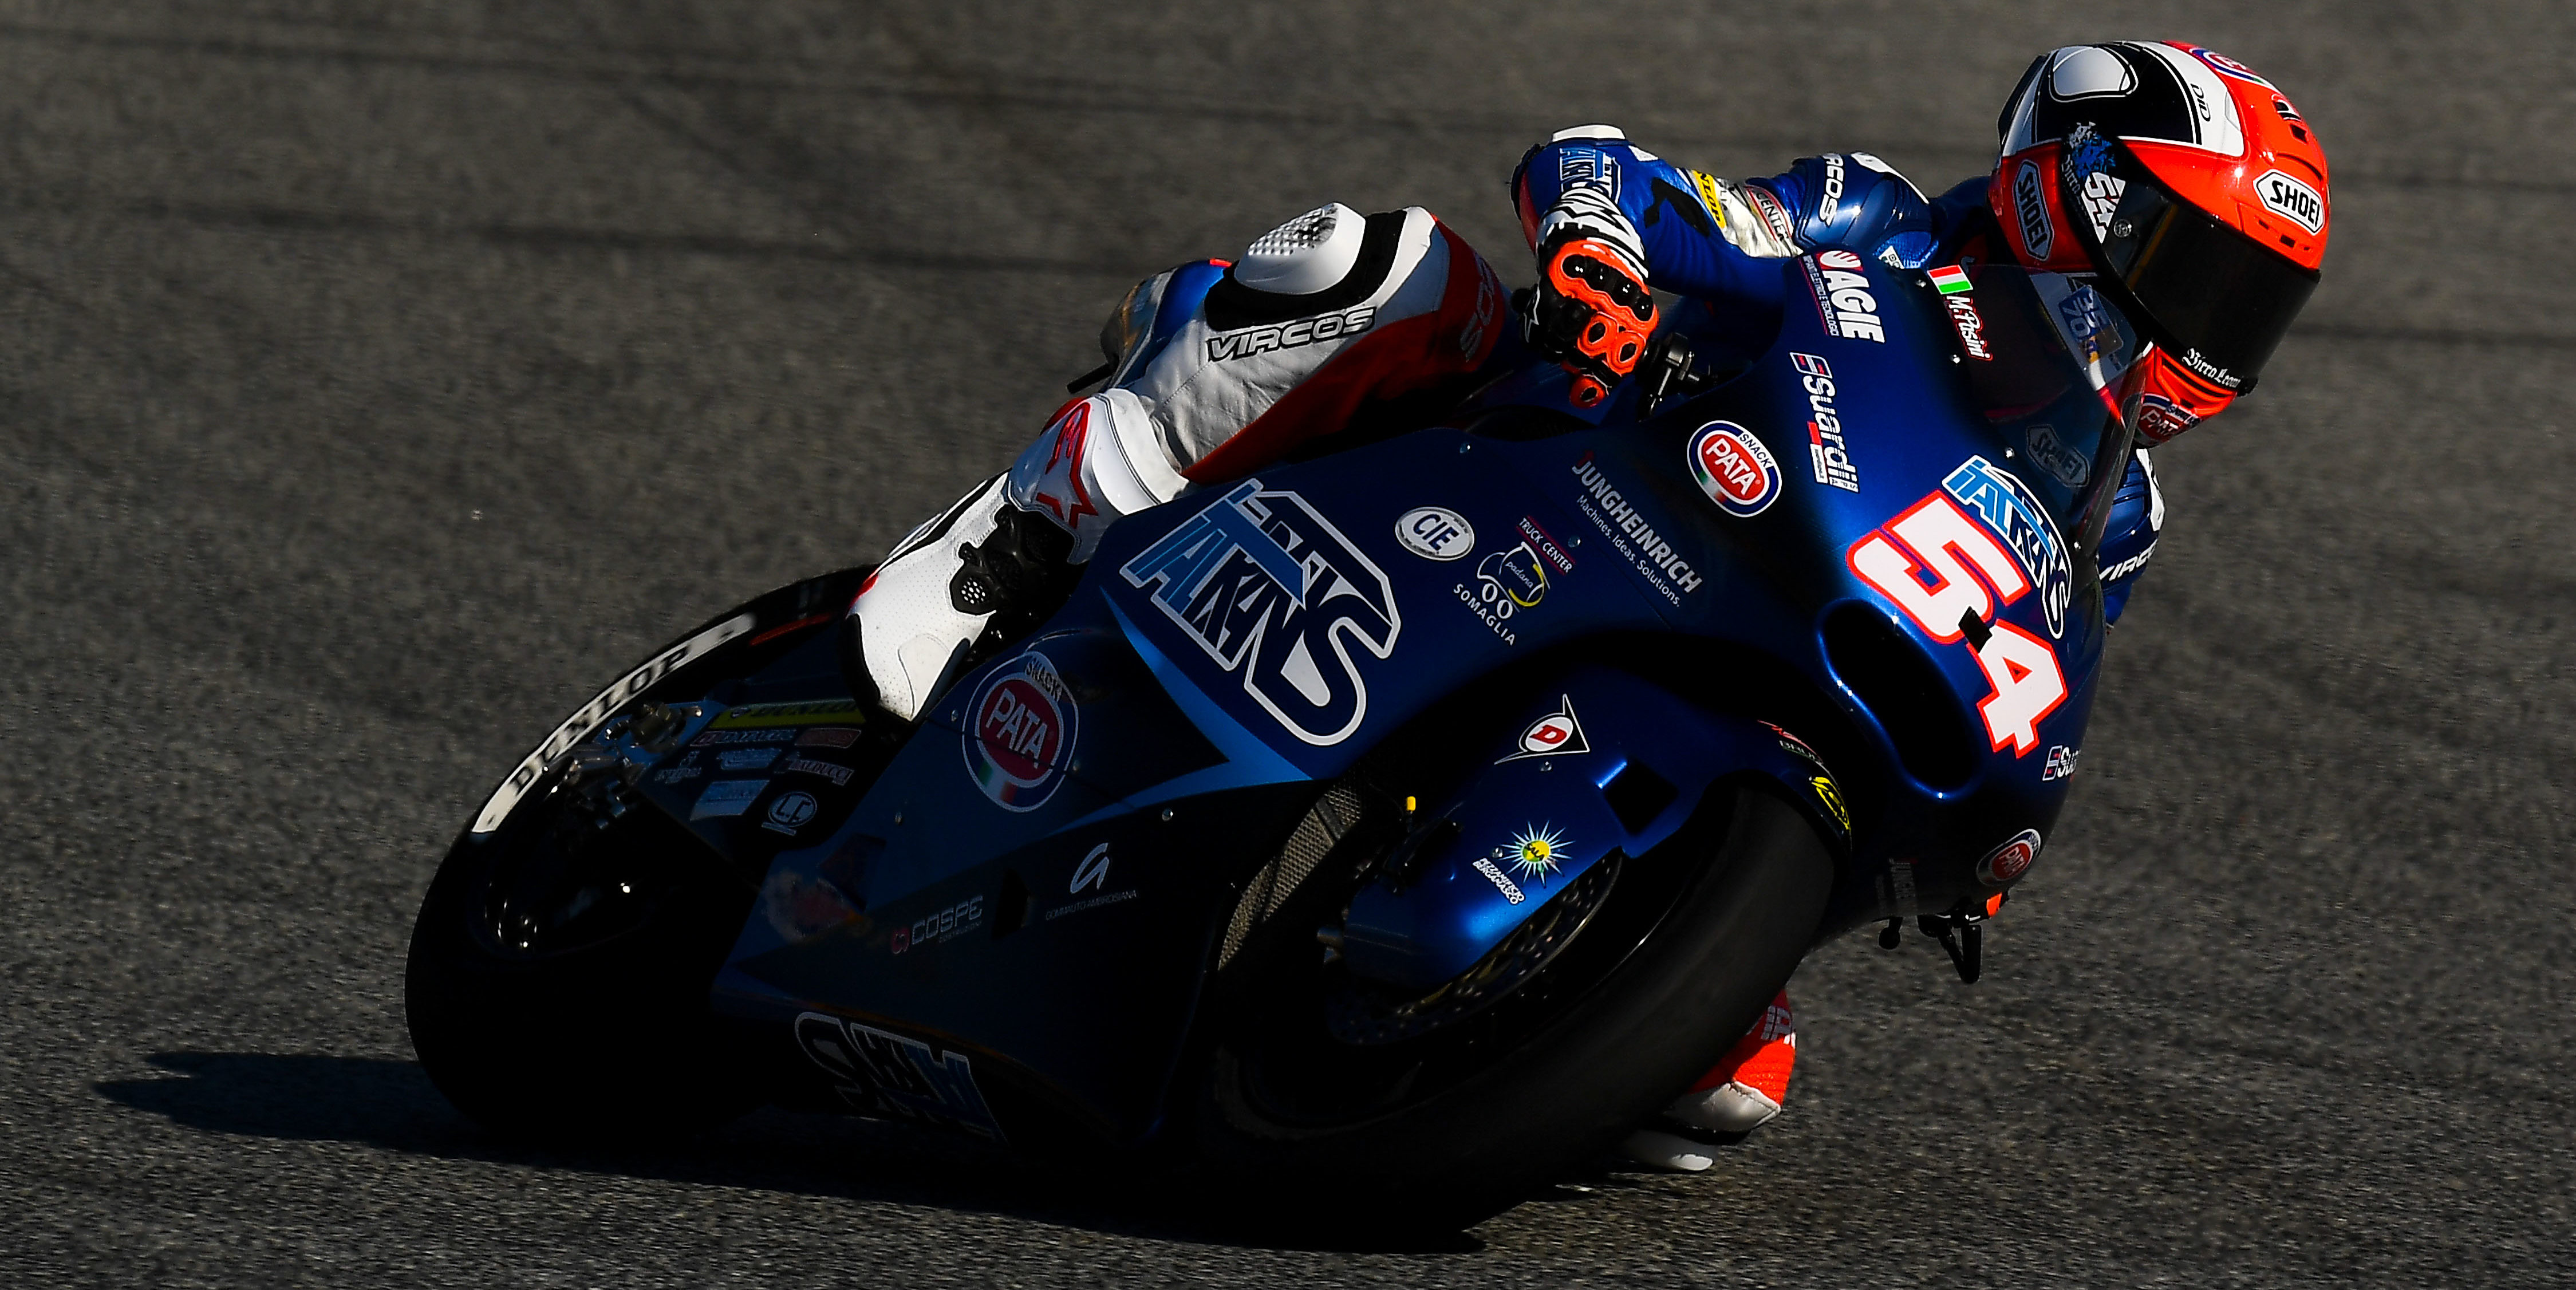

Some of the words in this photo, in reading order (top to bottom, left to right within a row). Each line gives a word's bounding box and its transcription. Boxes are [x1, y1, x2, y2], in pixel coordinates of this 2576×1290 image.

[1756, 192, 1790, 241] CENTER
[1818, 152, 1845, 227] RCOS
[2017, 176, 2049, 251] SHOEI
[2270, 180, 2321, 224] SHOEI
[1208, 307, 1376, 362] VIRCOS
[1821, 270, 1886, 344] AGIE
[1739, 433, 1772, 468] SNACK
[1802, 374, 1858, 482] Suardi
[1705, 437, 1757, 496] PATA
[1413, 514, 1459, 551] CIE
[1518, 517, 1544, 544] TRUCK
[1542, 542, 1573, 574] CENTER
[1571, 460, 1703, 594] JUNGHEINRICH
[1577, 494, 1612, 540] Machines.
[1612, 534, 1636, 565] Ideas.
[1636, 559, 1681, 608] Solutions.
[1505, 560, 1534, 589] padana
[2099, 538, 2158, 582] VIRC
[1453, 583, 1517, 646] SOMAGLIA
[1845, 488, 2070, 760] 54
[508, 645, 689, 796] DUNLOP
[985, 688, 1048, 770] PATA
[911, 894, 985, 946] COSPE
